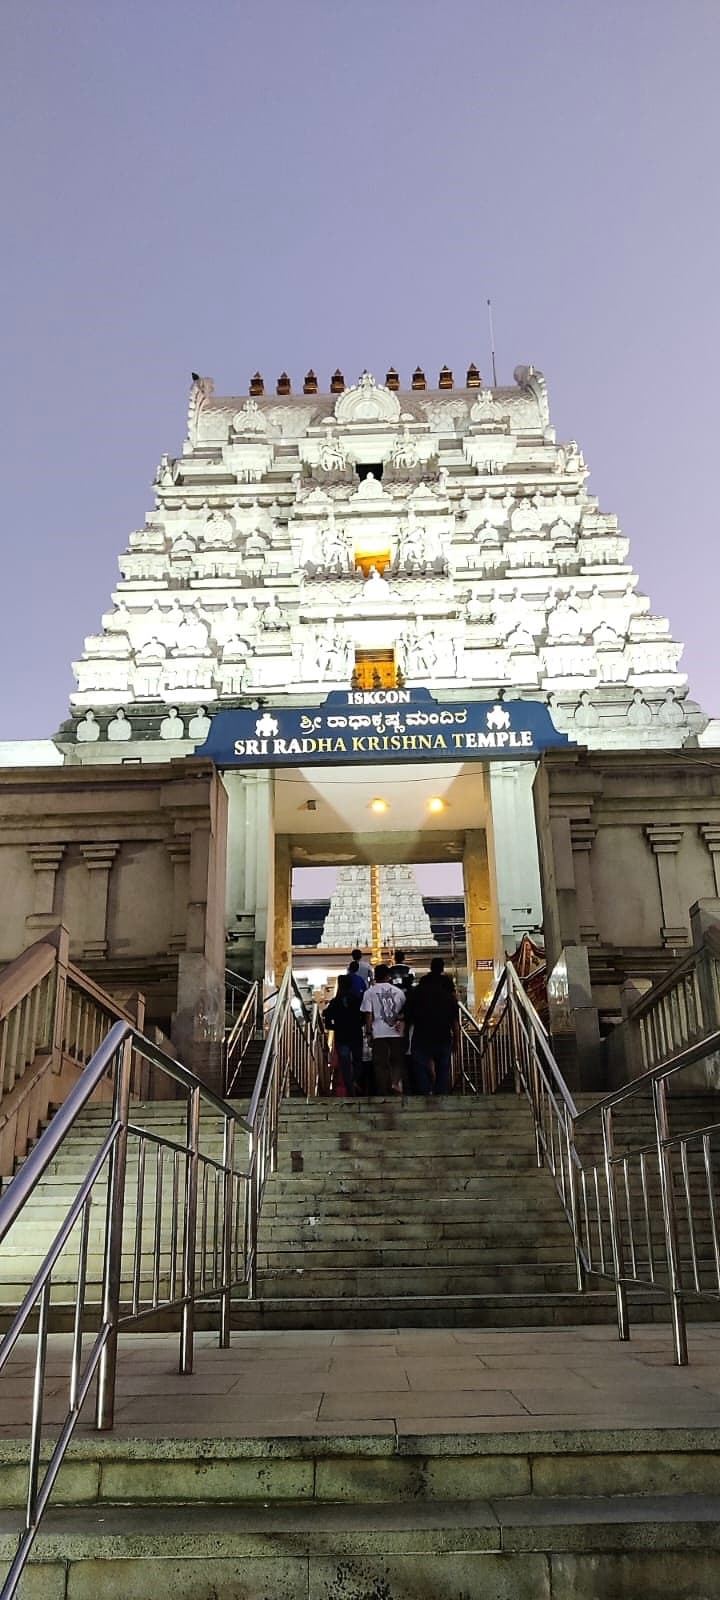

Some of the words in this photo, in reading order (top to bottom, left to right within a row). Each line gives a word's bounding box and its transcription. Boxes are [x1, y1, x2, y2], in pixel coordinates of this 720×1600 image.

[347, 691, 411, 705] ISKCON
[300, 715, 322, 735] ಶ್ರೀ
[405, 709, 467, 726] ಮಂದಿರ
[233, 740, 268, 755] SRI
[273, 738, 346, 755] RADHA
[352, 735, 447, 752] KRISHNA
[451, 732, 534, 748] TEMPLE
